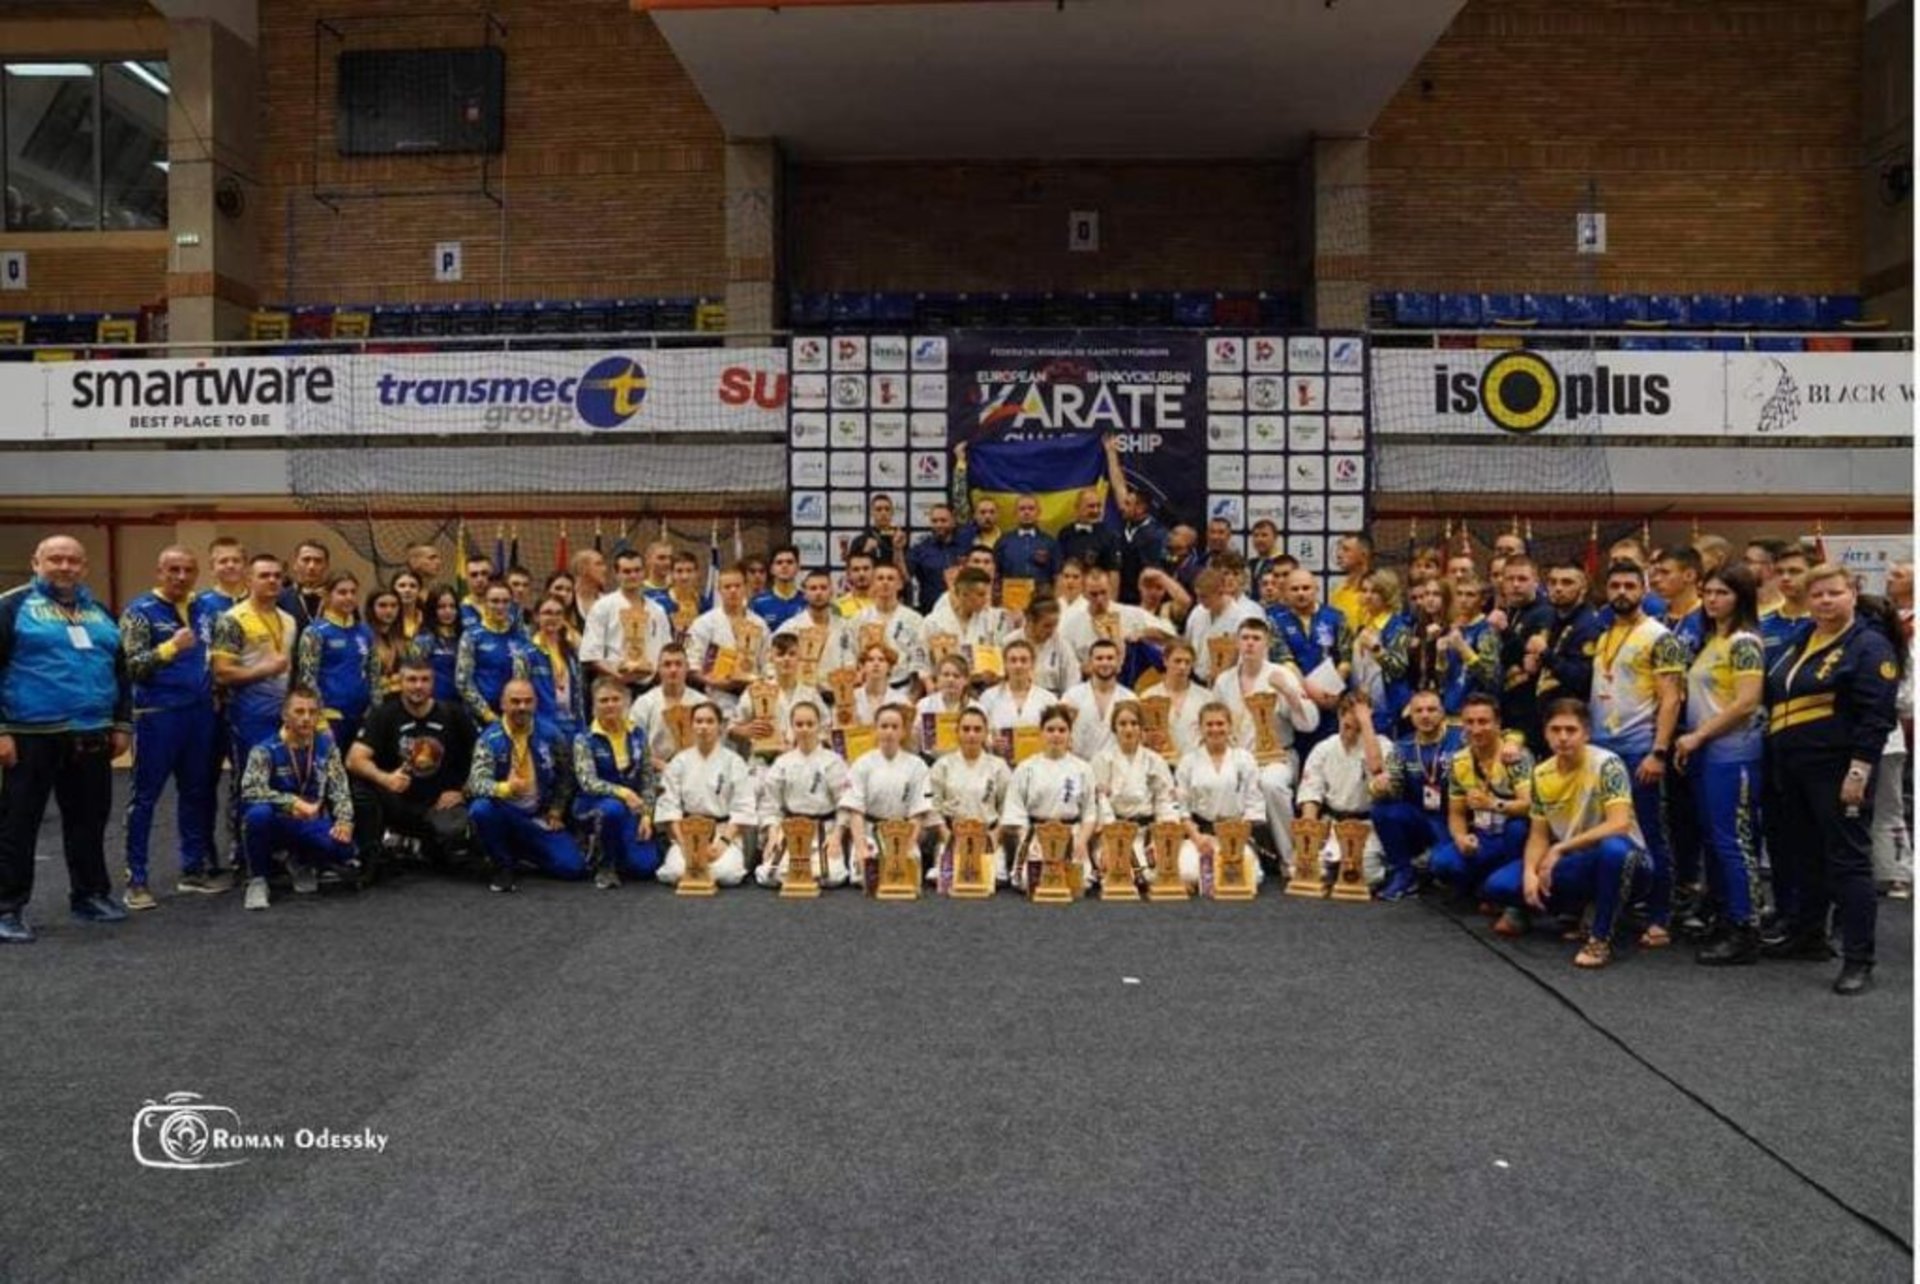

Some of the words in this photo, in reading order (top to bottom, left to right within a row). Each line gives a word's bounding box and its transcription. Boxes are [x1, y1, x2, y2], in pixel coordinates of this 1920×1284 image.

[443, 252, 455, 273] P
[72, 360, 334, 408] smartware
[977, 370, 1047, 383] EUROPEAN
[376, 373, 577, 406] transmec
[1808, 384, 1885, 403] BLACK
[978, 382, 1186, 429] KARATE
[130, 416, 167, 428] BEST
[173, 415, 221, 428] PLACE
[227, 415, 246, 427] TO
[250, 414, 271, 427] BE
[483, 406, 574, 431] group
